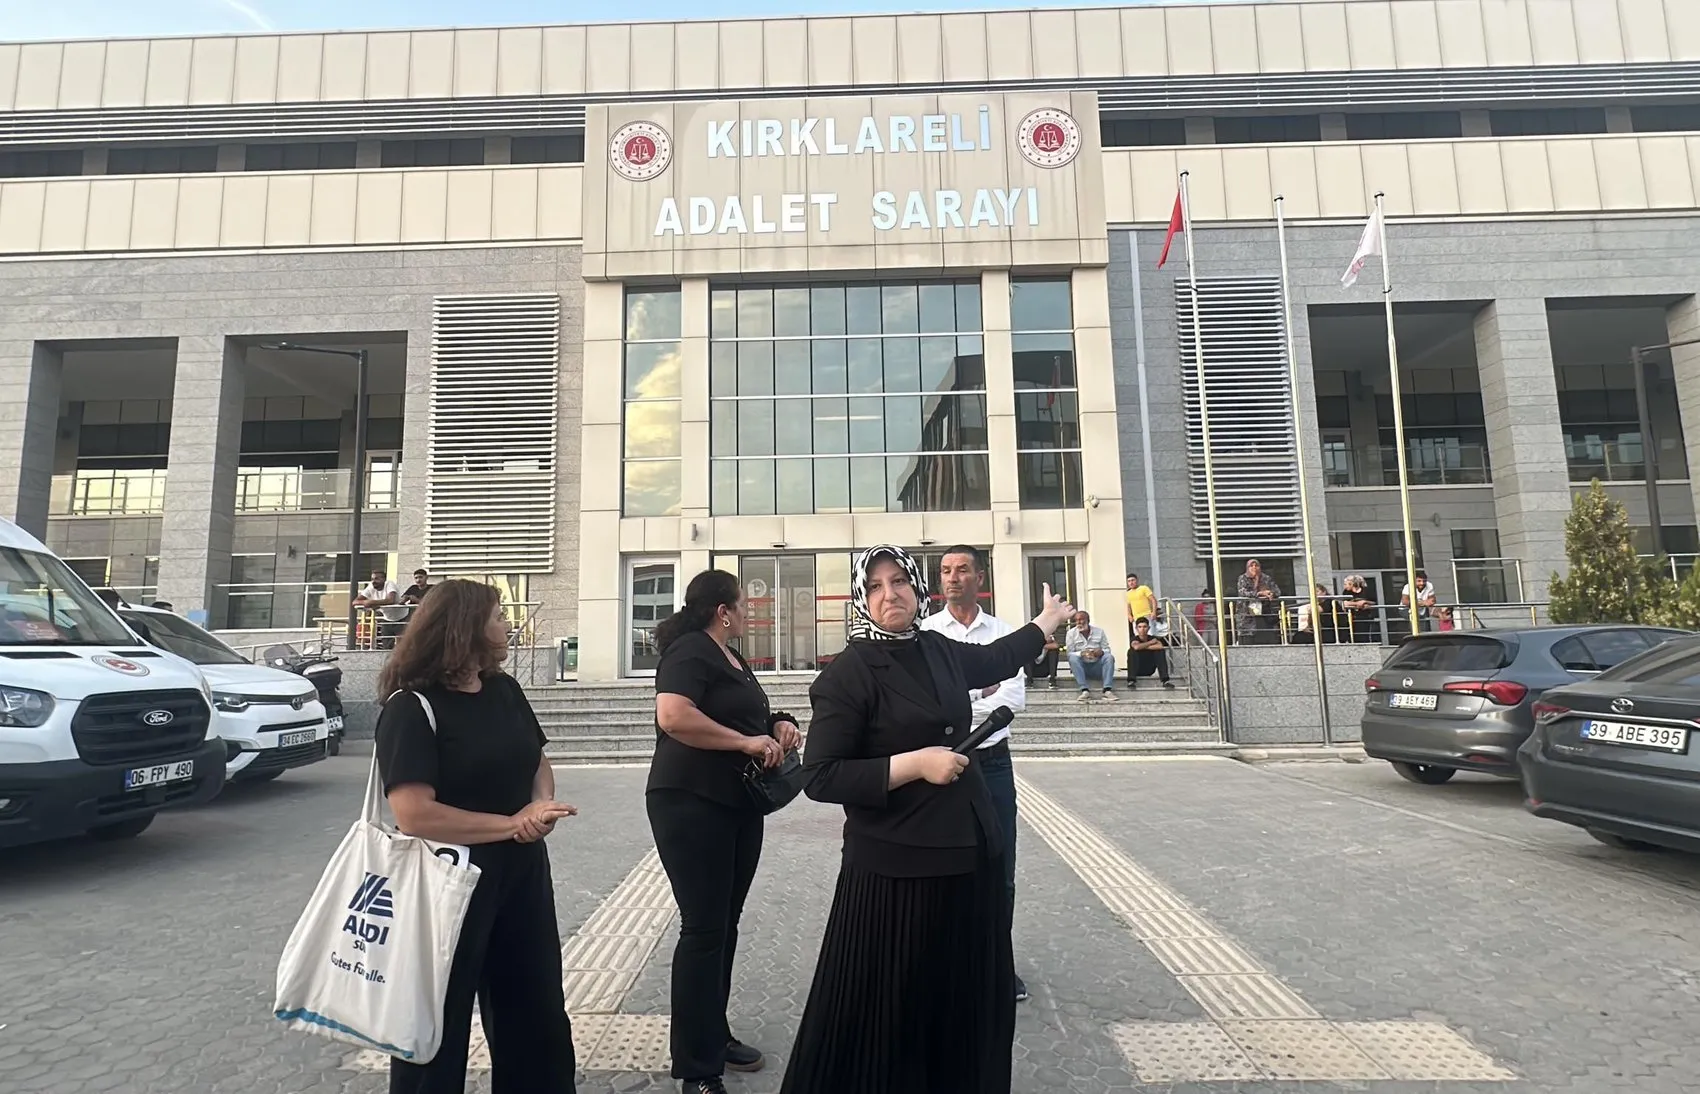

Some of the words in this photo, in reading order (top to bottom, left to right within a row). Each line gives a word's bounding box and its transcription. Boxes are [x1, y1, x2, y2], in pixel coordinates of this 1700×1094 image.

[707, 104, 991, 158] KIRKLARELİ
[653, 192, 838, 237] ADALET
[871, 187, 1039, 231] SARAYI
[148, 712, 169, 723] Ford
[282, 735, 291, 746] 34
[1589, 723, 1608, 738] 39
[1616, 725, 1646, 742] ABE
[1650, 729, 1682, 746] 395
[131, 769, 145, 785] 06
[151, 765, 169, 782] FPY
[174, 761, 192, 777] 490
[343, 914, 390, 946] ALDI
[353, 939, 366, 953] SÜ
